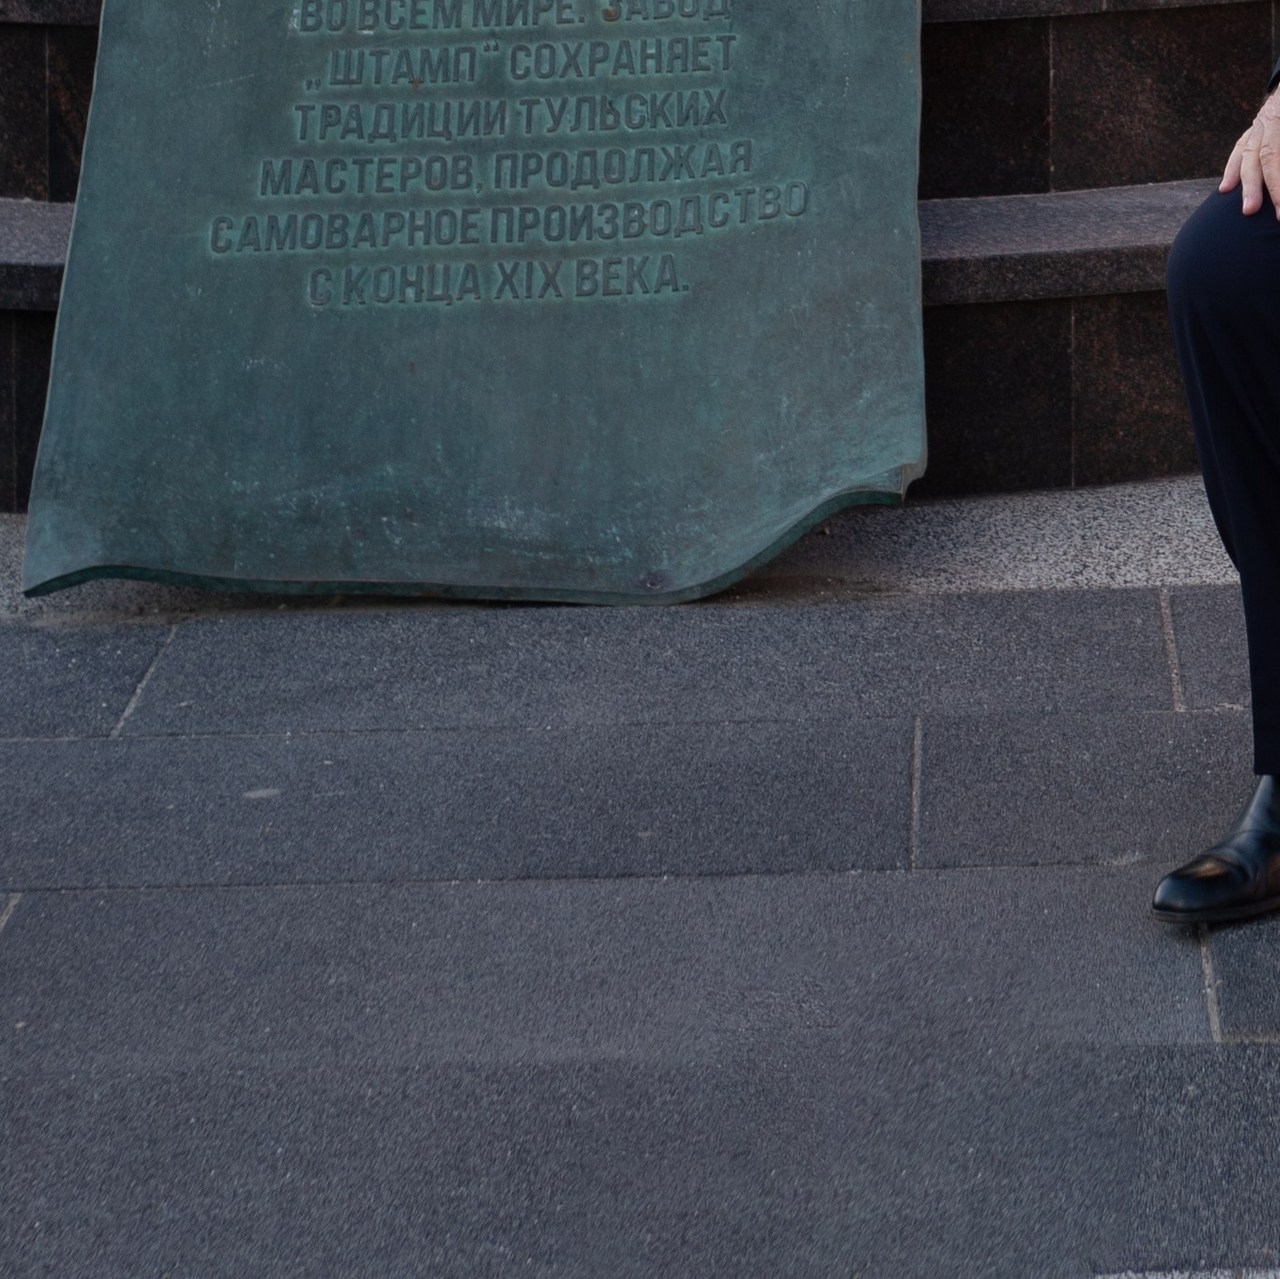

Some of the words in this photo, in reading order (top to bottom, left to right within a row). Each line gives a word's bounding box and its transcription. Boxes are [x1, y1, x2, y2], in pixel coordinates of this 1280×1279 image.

[509, 35, 737, 80] СОХРАНЯЕТ
[295, 99, 506, 142] ТРАДИЦИИ
[519, 89, 727, 134] ТУЛЬСКИХ
[260, 155, 482, 196] МАСТЕРОВ,
[494, 140, 753, 190] ПРОДОЛЖАЯ
[210, 208, 481, 253] САМОВАРНОЕ
[491, 181, 808, 242] ПРОИЗВОДСТВО
[309, 268, 331, 305] С
[341, 262, 481, 305] КОНЦА
[495, 261, 563, 300] XIX
[575, 254, 690, 297] ВЕКА.
